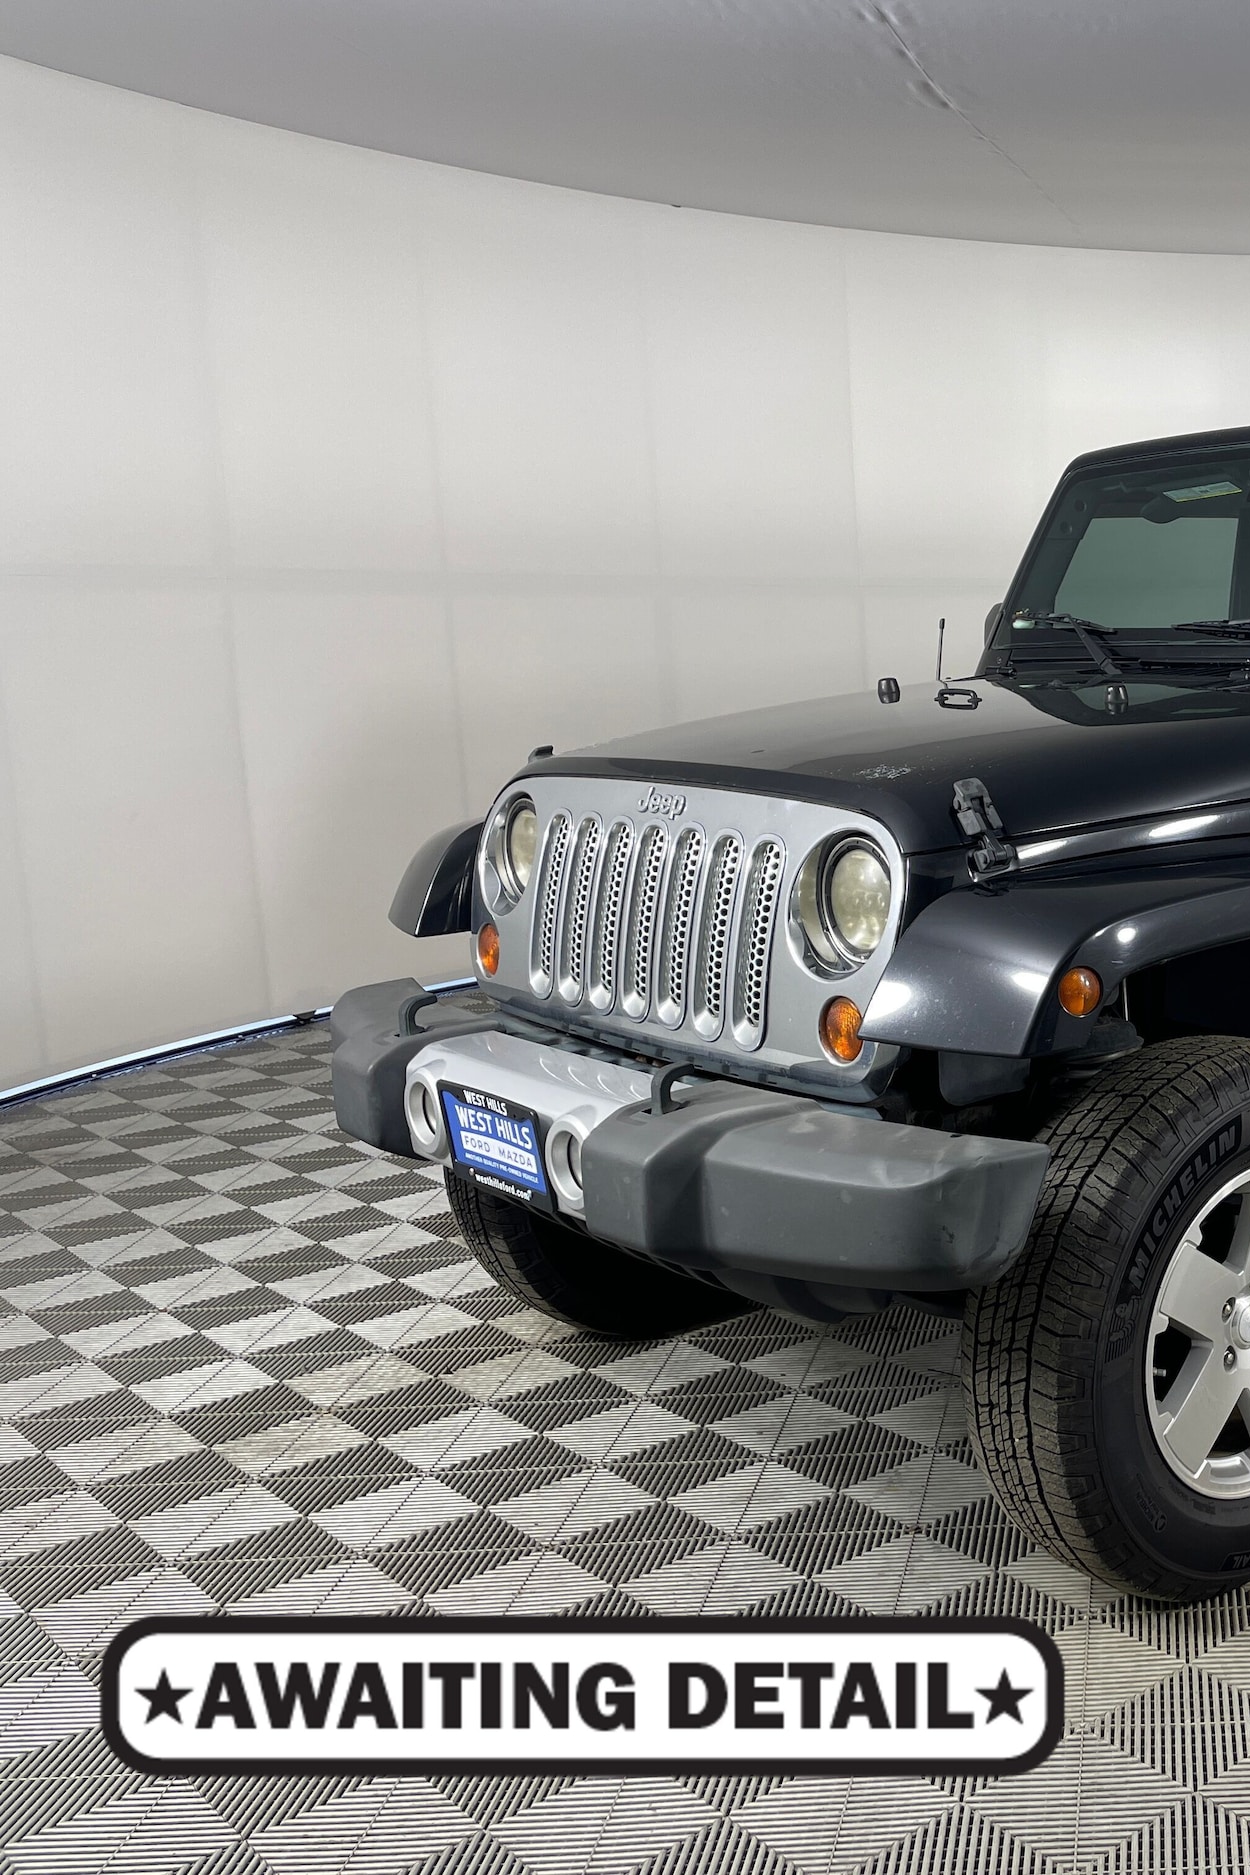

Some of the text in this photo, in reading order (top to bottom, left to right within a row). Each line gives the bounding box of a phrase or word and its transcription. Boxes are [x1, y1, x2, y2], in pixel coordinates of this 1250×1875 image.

[637, 786, 686, 820] Jeep
[463, 1090, 507, 1116] WEST HILLS
[455, 1105, 532, 1149] WEST HILLS
[464, 1136, 533, 1168] FORD MAZDA
[1128, 1125, 1236, 1290] MICHELIN
